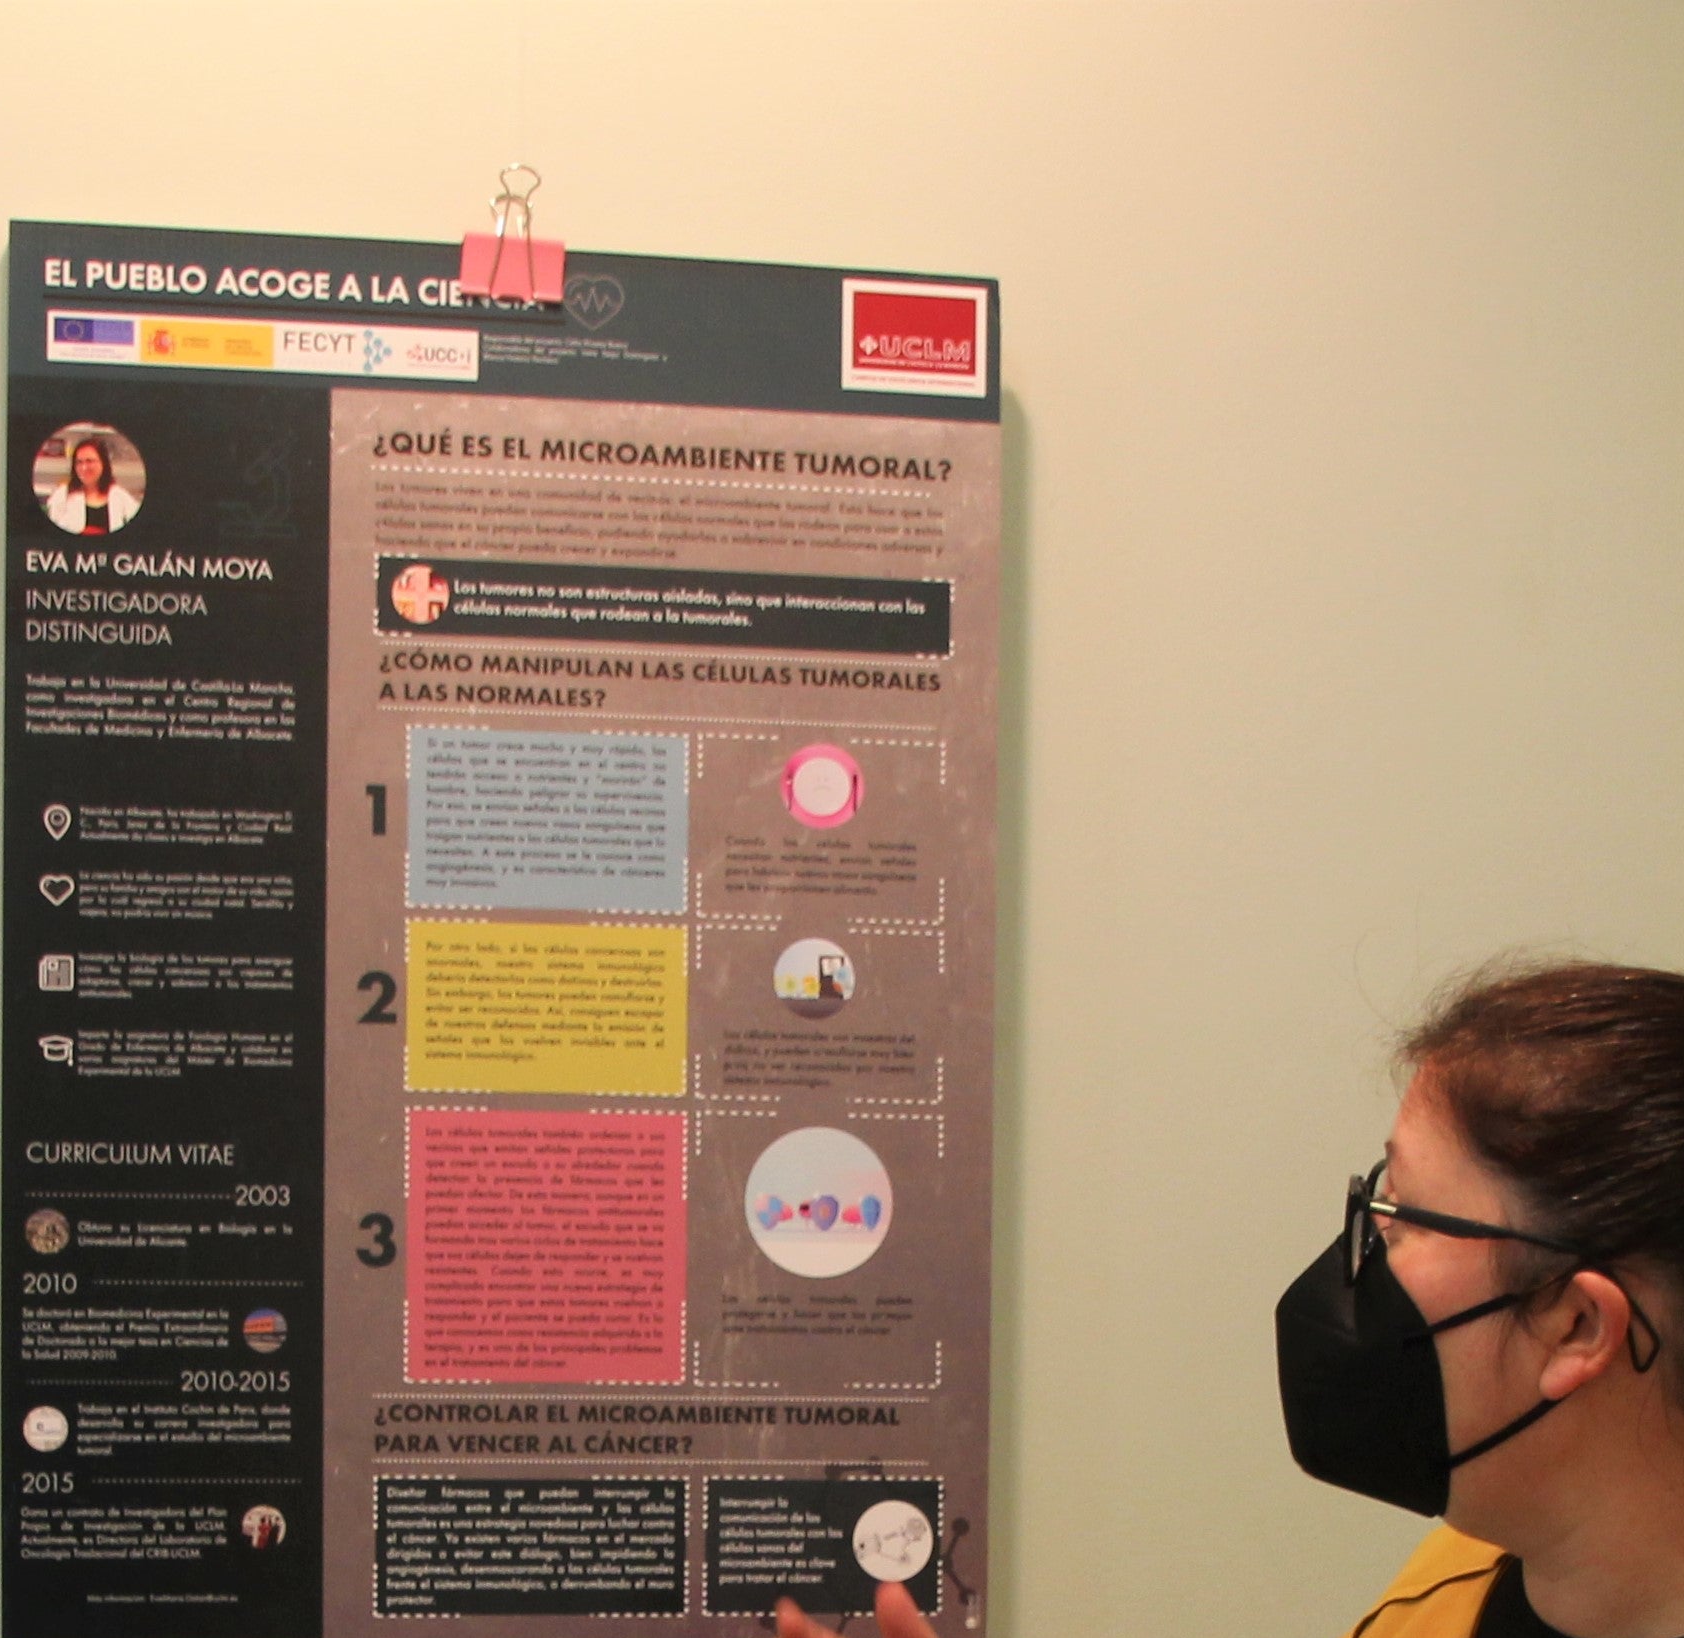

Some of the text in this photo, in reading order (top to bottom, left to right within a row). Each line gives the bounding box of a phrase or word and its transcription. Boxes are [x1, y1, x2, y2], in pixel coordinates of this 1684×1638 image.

[44, 258, 76, 287] EL
[85, 261, 207, 293] PUEBLO
[215, 267, 330, 300] ACOGE
[338, 273, 362, 302] A
[370, 275, 409, 304] LA
[283, 331, 357, 353] FECYT
[879, 334, 972, 361] UCLM
[372, 428, 952, 481] ¿QUÉ ES EL MICROAMBIENTE TUMORAL?
[26, 550, 68, 573] EVA
[113, 551, 195, 577] GALÁN
[202, 557, 273, 580] MOYA
[26, 588, 207, 615] INVESTIGADORA
[453, 579, 477, 595] Los
[478, 582, 534, 597] tumores
[536, 585, 556, 597] no
[558, 586, 583, 599] son
[585, 586, 659, 602] estructuras
[725, 592, 753, 606] sino
[755, 595, 782, 611] que
[784, 595, 876, 611] interaccionan
[878, 601, 903, 613] con
[905, 599, 925, 614] las
[453, 598, 501, 616] células
[503, 602, 568, 618] normales
[570, 607, 597, 623] que
[599, 605, 650, 622] rodean
[652, 611, 663, 622] a
[665, 608, 680, 623] la
[25, 619, 172, 645] DISTINGUIDA
[379, 648, 941, 692] ¿CÓMO MANIPULAN LAS CÉLULAS TUMORALES
[378, 682, 606, 707] A LAS NORMALES?
[366, 784, 387, 836] 1
[356, 969, 398, 1025] 2
[26, 1142, 234, 1165] CURRICULUM VITAE
[235, 1184, 290, 1206] 2003
[356, 1212, 398, 1269] 3
[23, 1272, 77, 1294] 2010
[180, 1370, 290, 1392] 2010-2015
[374, 1403, 900, 1428] ¿CONTROLAR EL MICROAMBIENTE TUMORAL
[373, 1431, 693, 1454] PARA VENCER AL CÁNCER?
[22, 1472, 74, 1493] 2015
